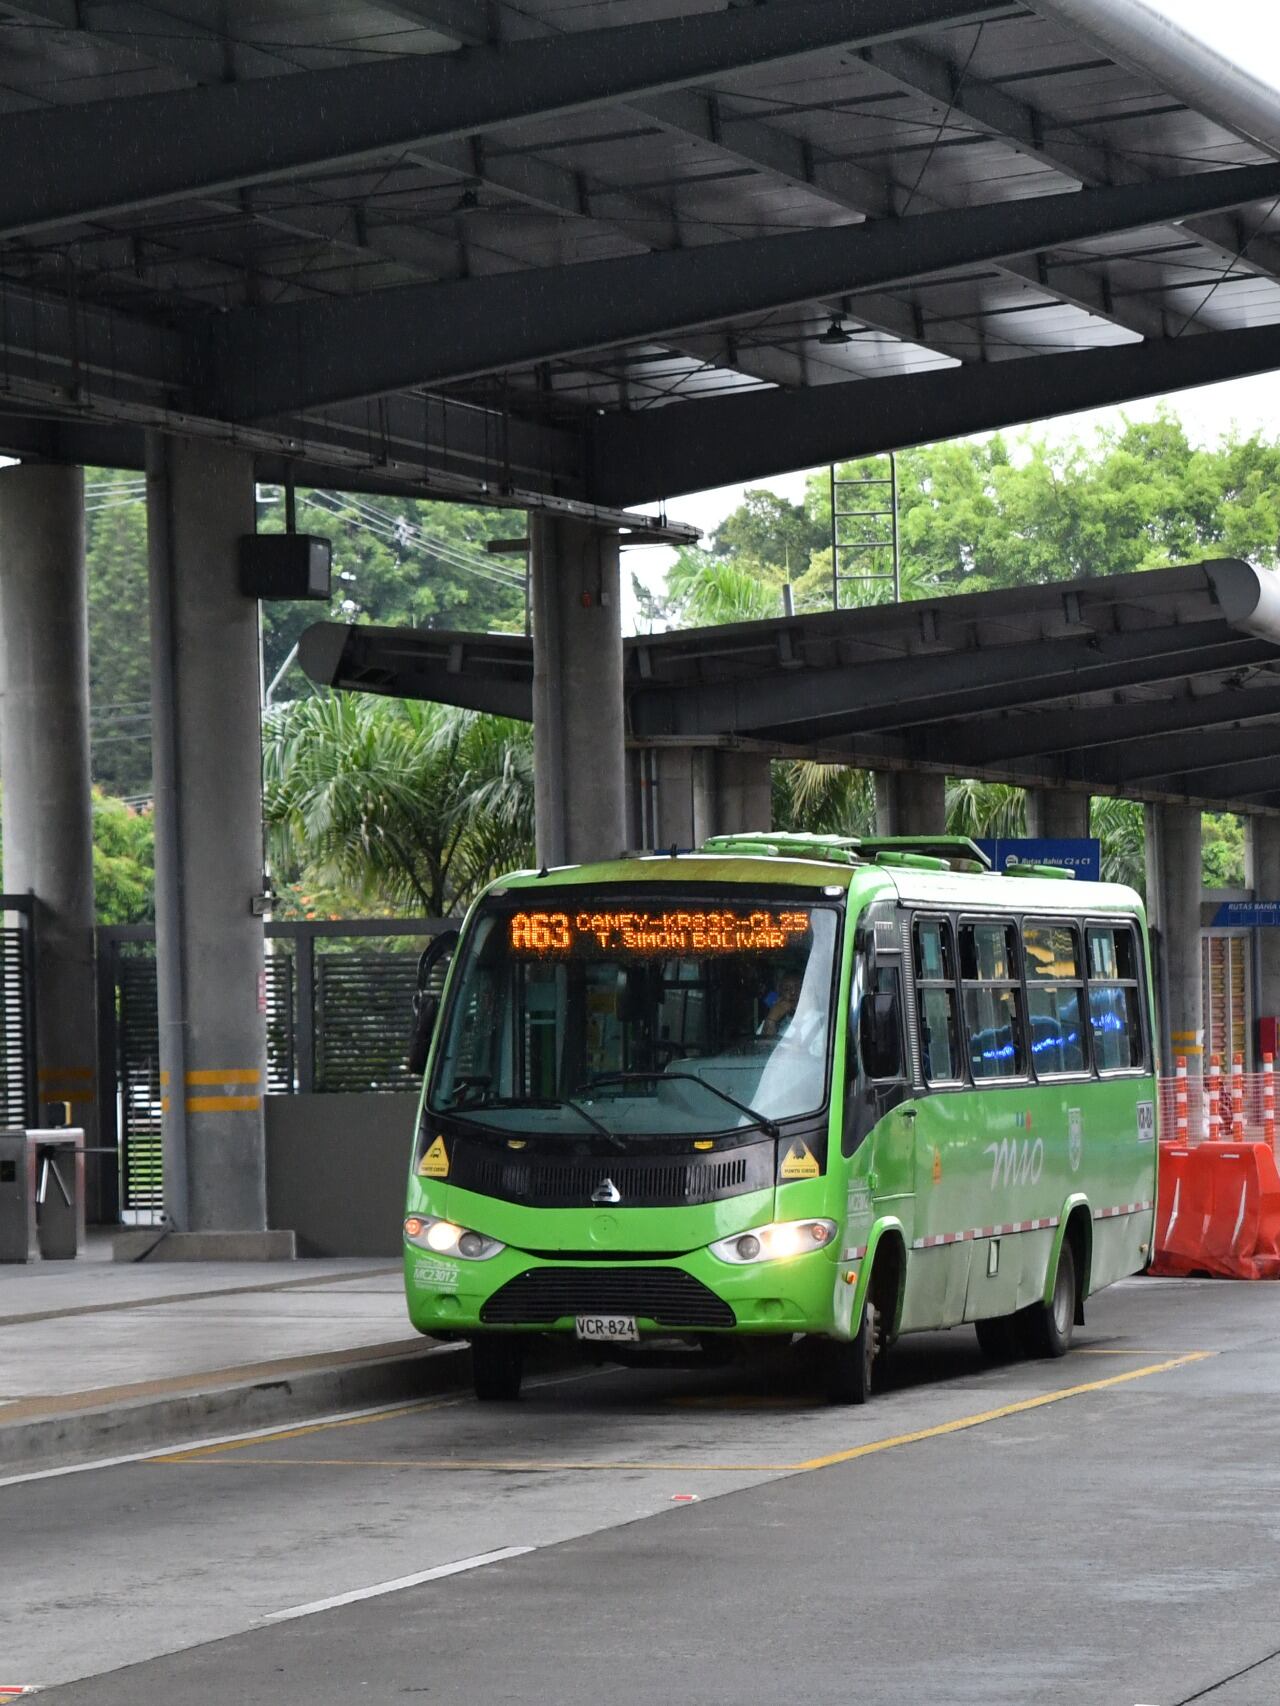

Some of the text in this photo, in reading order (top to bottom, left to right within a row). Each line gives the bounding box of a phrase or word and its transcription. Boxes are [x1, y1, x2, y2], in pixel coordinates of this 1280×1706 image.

[1064, 857, 1074, 865] C2
[1080, 857, 1091, 865] C1
[1228, 903, 1253, 911] RUTAS
[511, 913, 569, 948] A63
[600, 931, 785, 948] T. SIMON BOLIVAR
